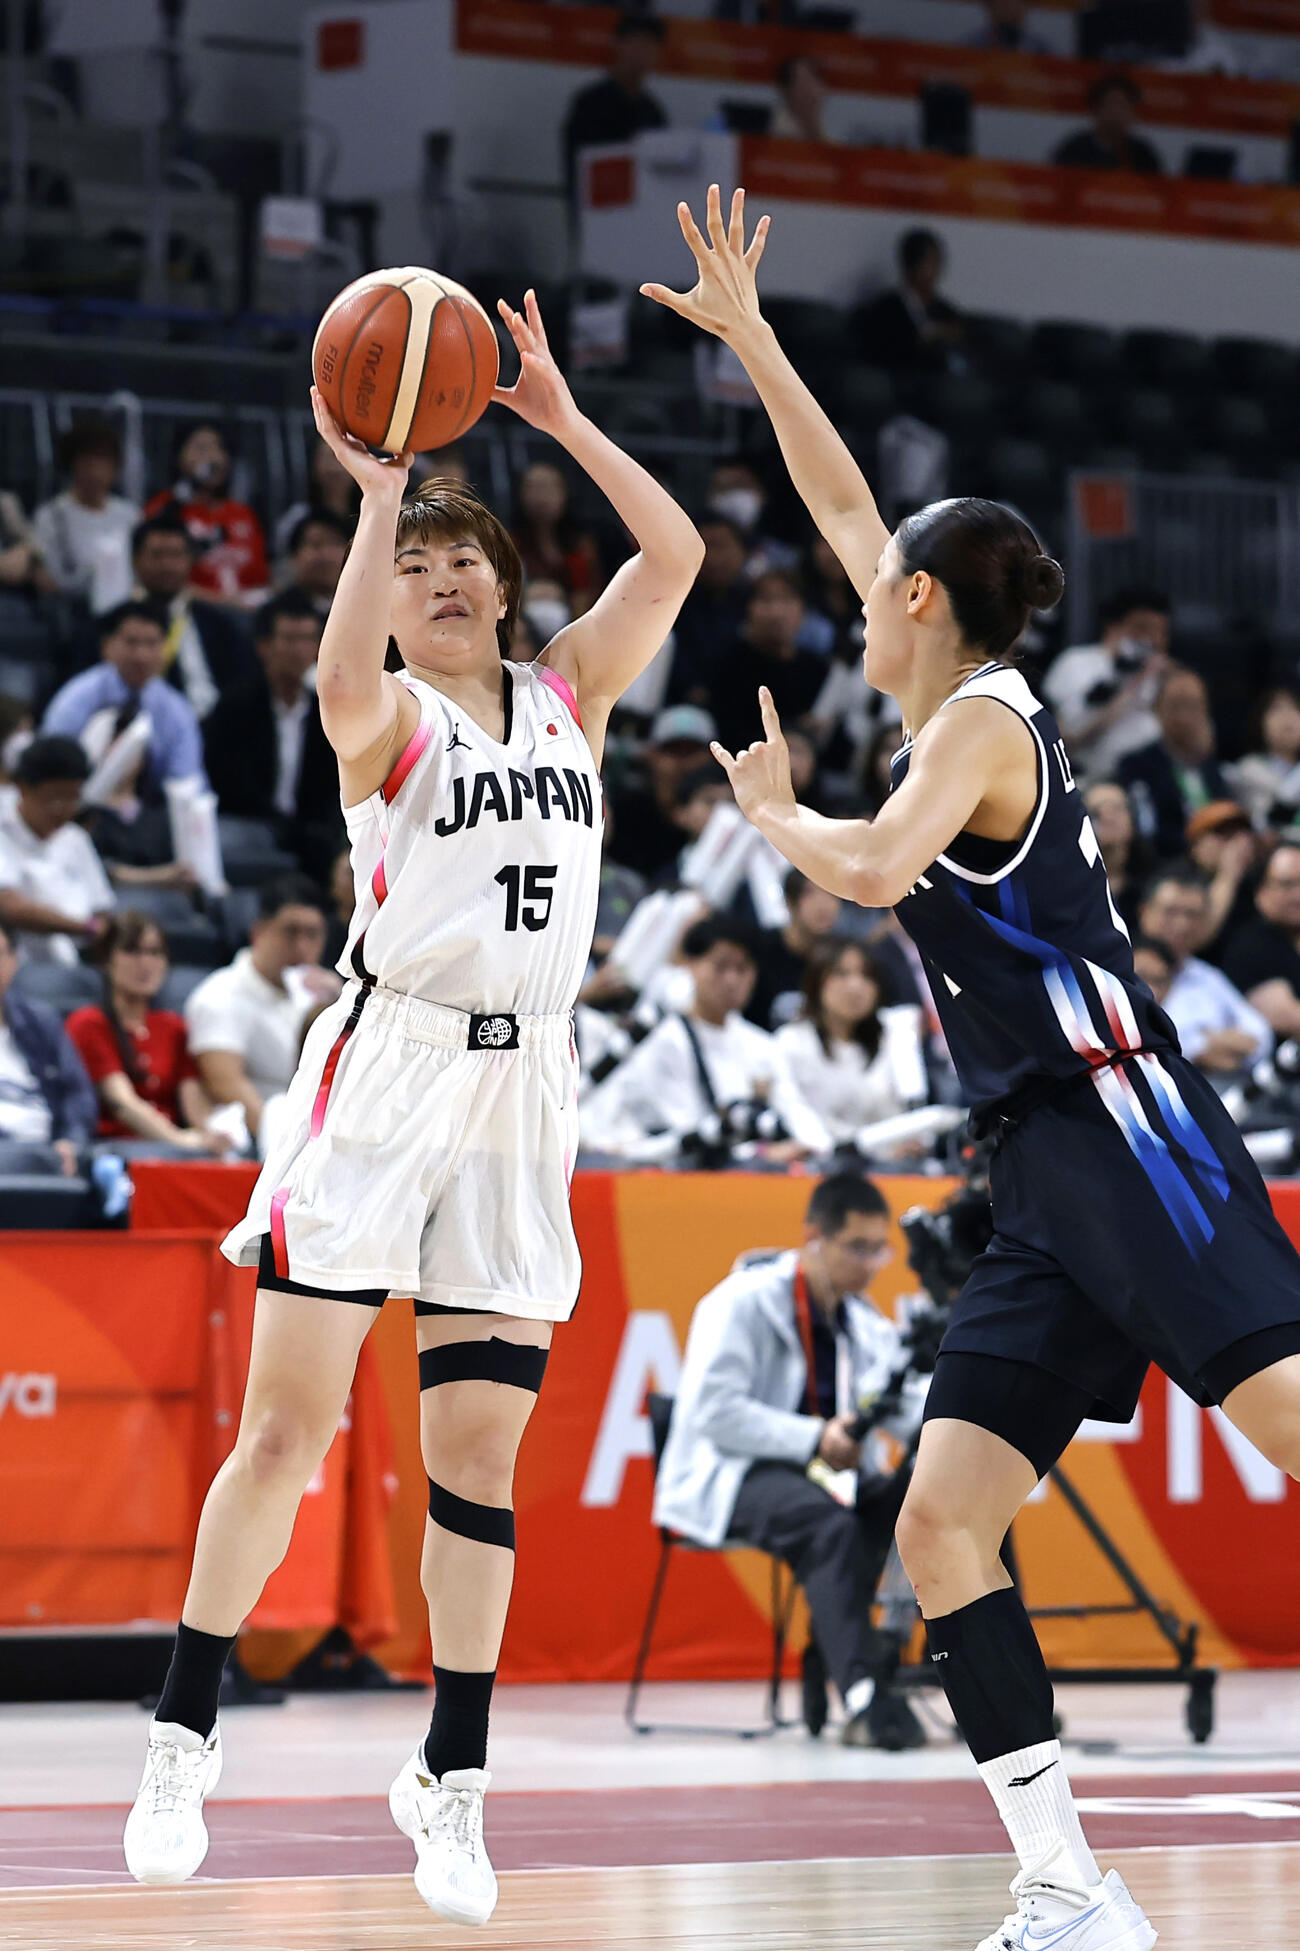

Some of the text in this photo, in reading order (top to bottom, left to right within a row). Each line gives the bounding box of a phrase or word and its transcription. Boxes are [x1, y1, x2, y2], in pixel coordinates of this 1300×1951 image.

[355, 342, 384, 419] molten
[434, 766, 594, 838] JAPAN
[493, 864, 559, 932] 15
